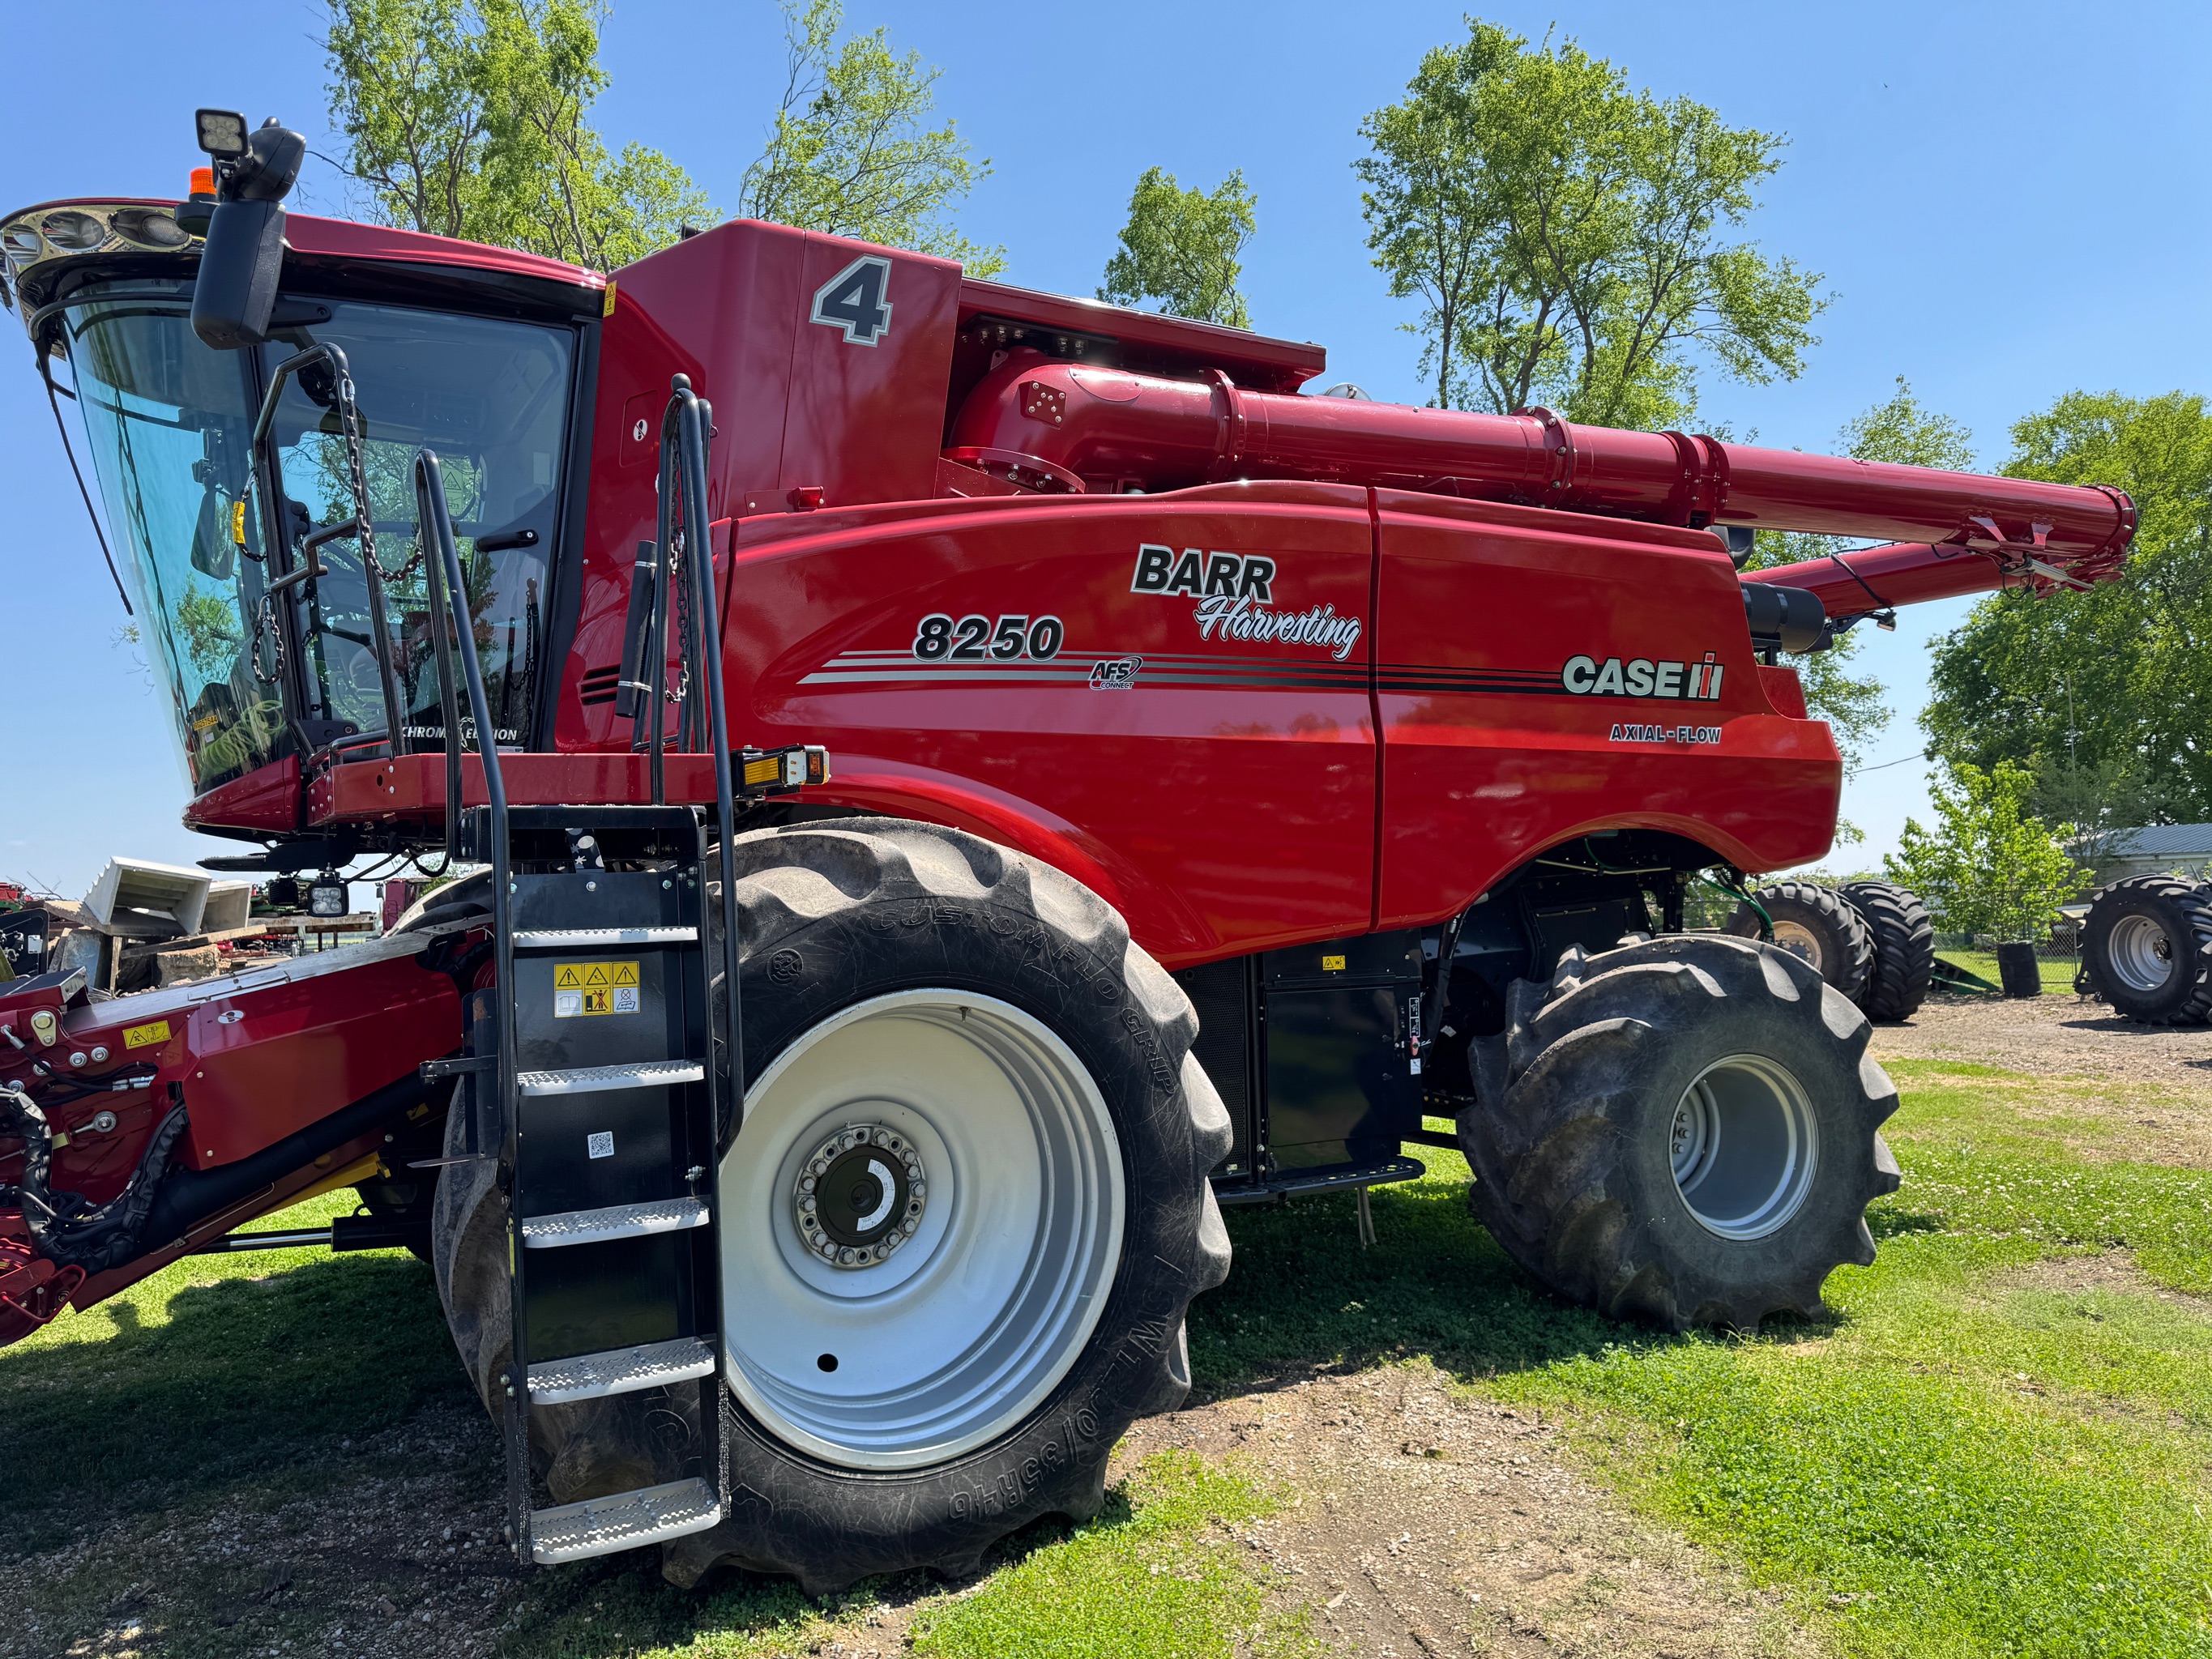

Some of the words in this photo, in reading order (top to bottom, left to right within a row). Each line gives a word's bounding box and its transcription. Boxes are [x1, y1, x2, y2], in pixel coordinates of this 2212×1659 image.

[809, 253, 893, 348] 4
[1130, 543, 1276, 604] BARR
[912, 613, 1064, 663] 8250
[1193, 593, 1361, 661] Harvesting
[1088, 660, 1133, 681] AFS
[1100, 681, 1134, 690] CONNECT
[1562, 655, 1685, 697] CASE
[402, 726, 452, 739] CHROM
[1608, 723, 1722, 744] AXIAL-FLOW
[870, 905, 1050, 948] CUSTOM
[1121, 1007, 1176, 1094] GRIP
